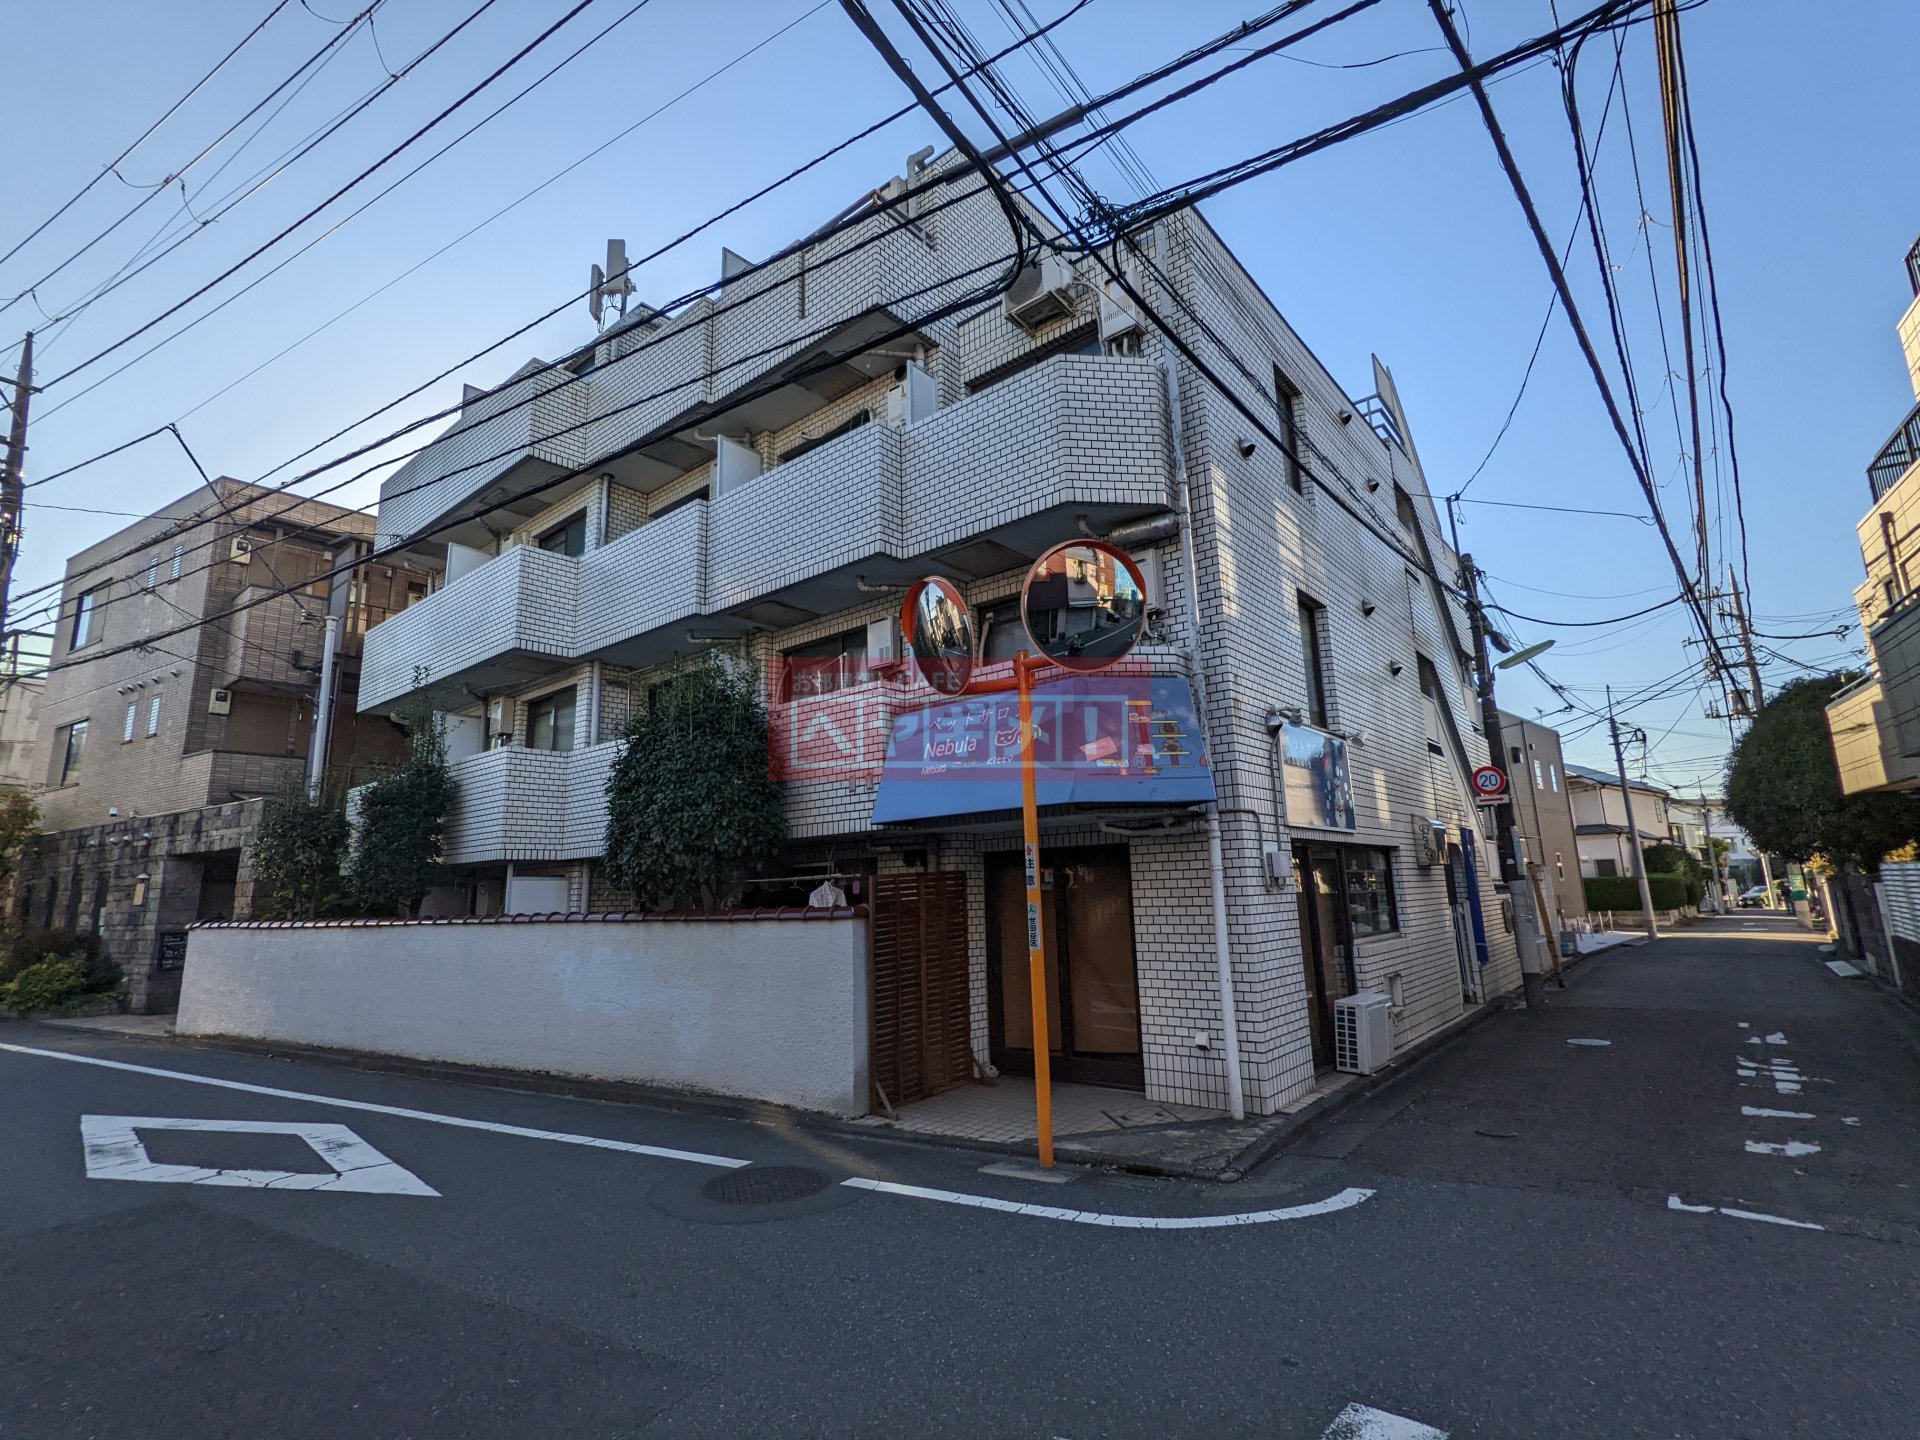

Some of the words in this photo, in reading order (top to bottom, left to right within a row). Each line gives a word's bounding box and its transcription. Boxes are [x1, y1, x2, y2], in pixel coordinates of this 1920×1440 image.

[923, 735, 977, 759] Nebula
[1480, 772, 1499, 788] 20
[1028, 916, 1038, 948] 世田谷区
